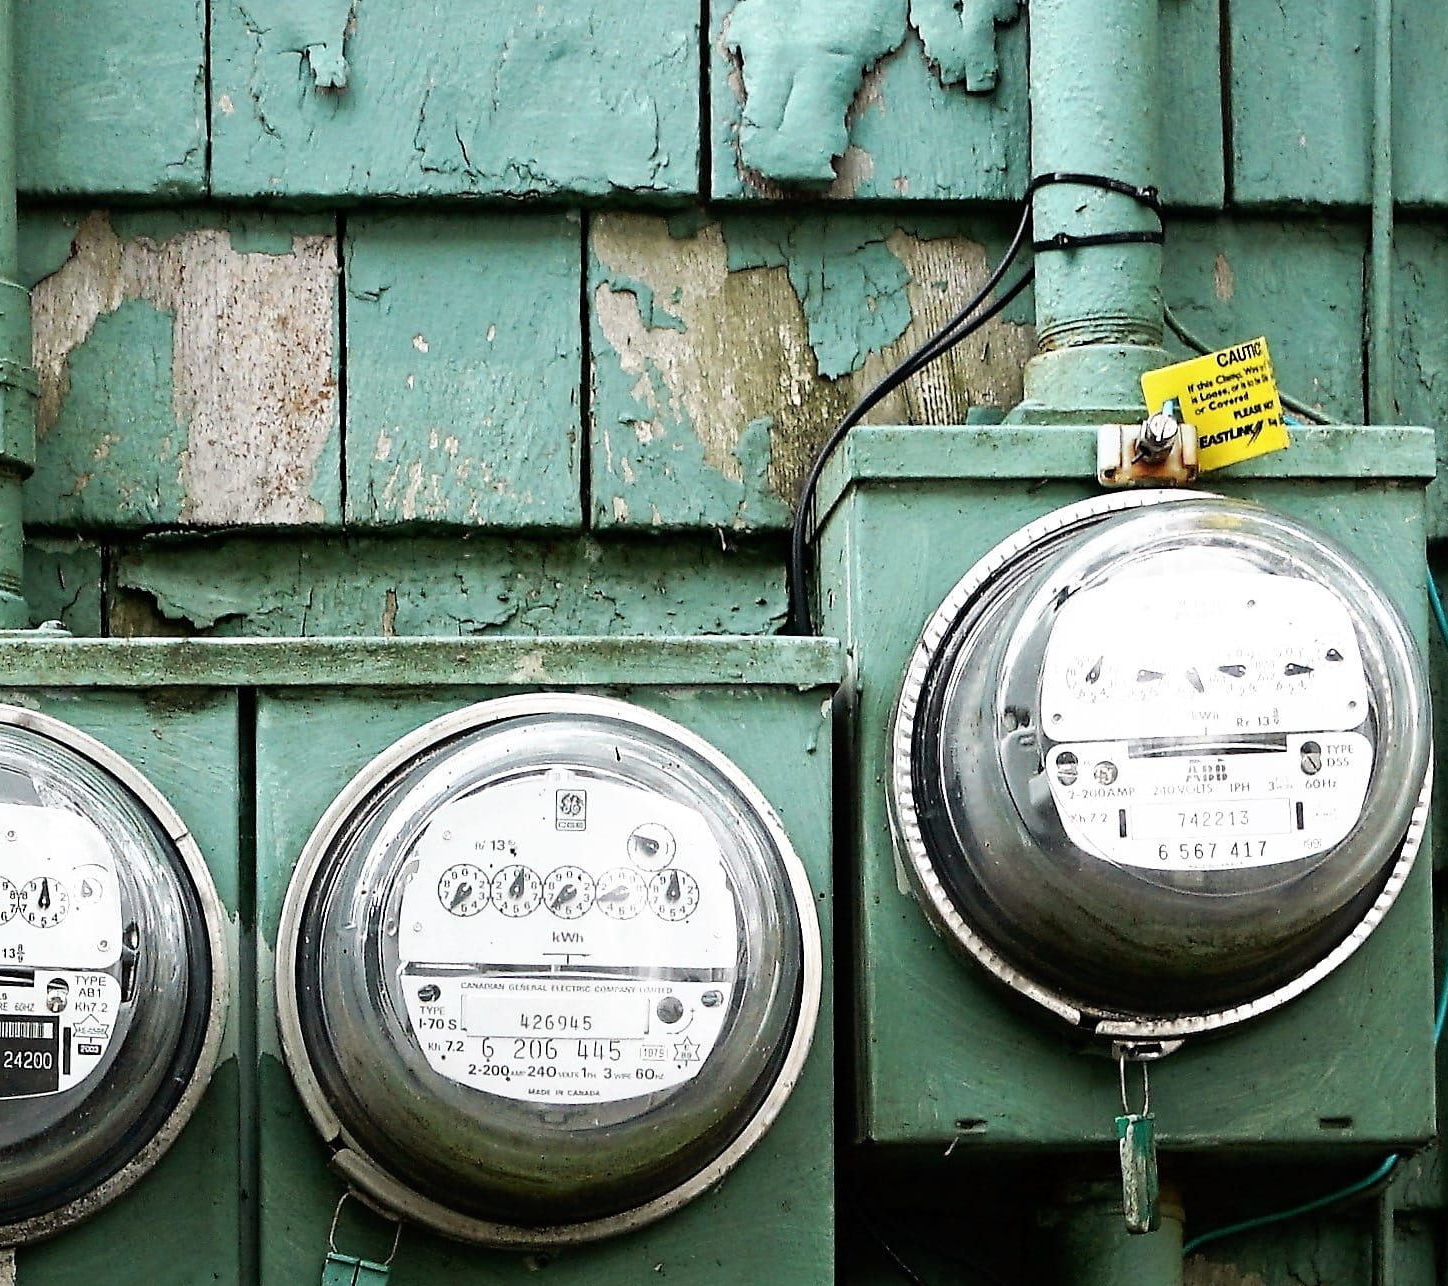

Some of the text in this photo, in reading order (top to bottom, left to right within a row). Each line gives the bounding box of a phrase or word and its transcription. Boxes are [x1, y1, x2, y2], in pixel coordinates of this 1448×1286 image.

[1326, 744, 1354, 754] TYPE
[1178, 810, 1249, 828] 742213
[1158, 840, 1267, 860] 6 567 417
[552, 931, 584, 943] kWh
[74, 976, 107, 987] TYPE
[78, 988, 102, 998] AB1
[419, 1006, 445, 1016] TYPE
[520, 1013, 592, 1030] 426945
[445, 1040, 465, 1052] 7.2
[482, 1037, 621, 1061] 6 206 445
[3, 1051, 52, 1070] 24200
